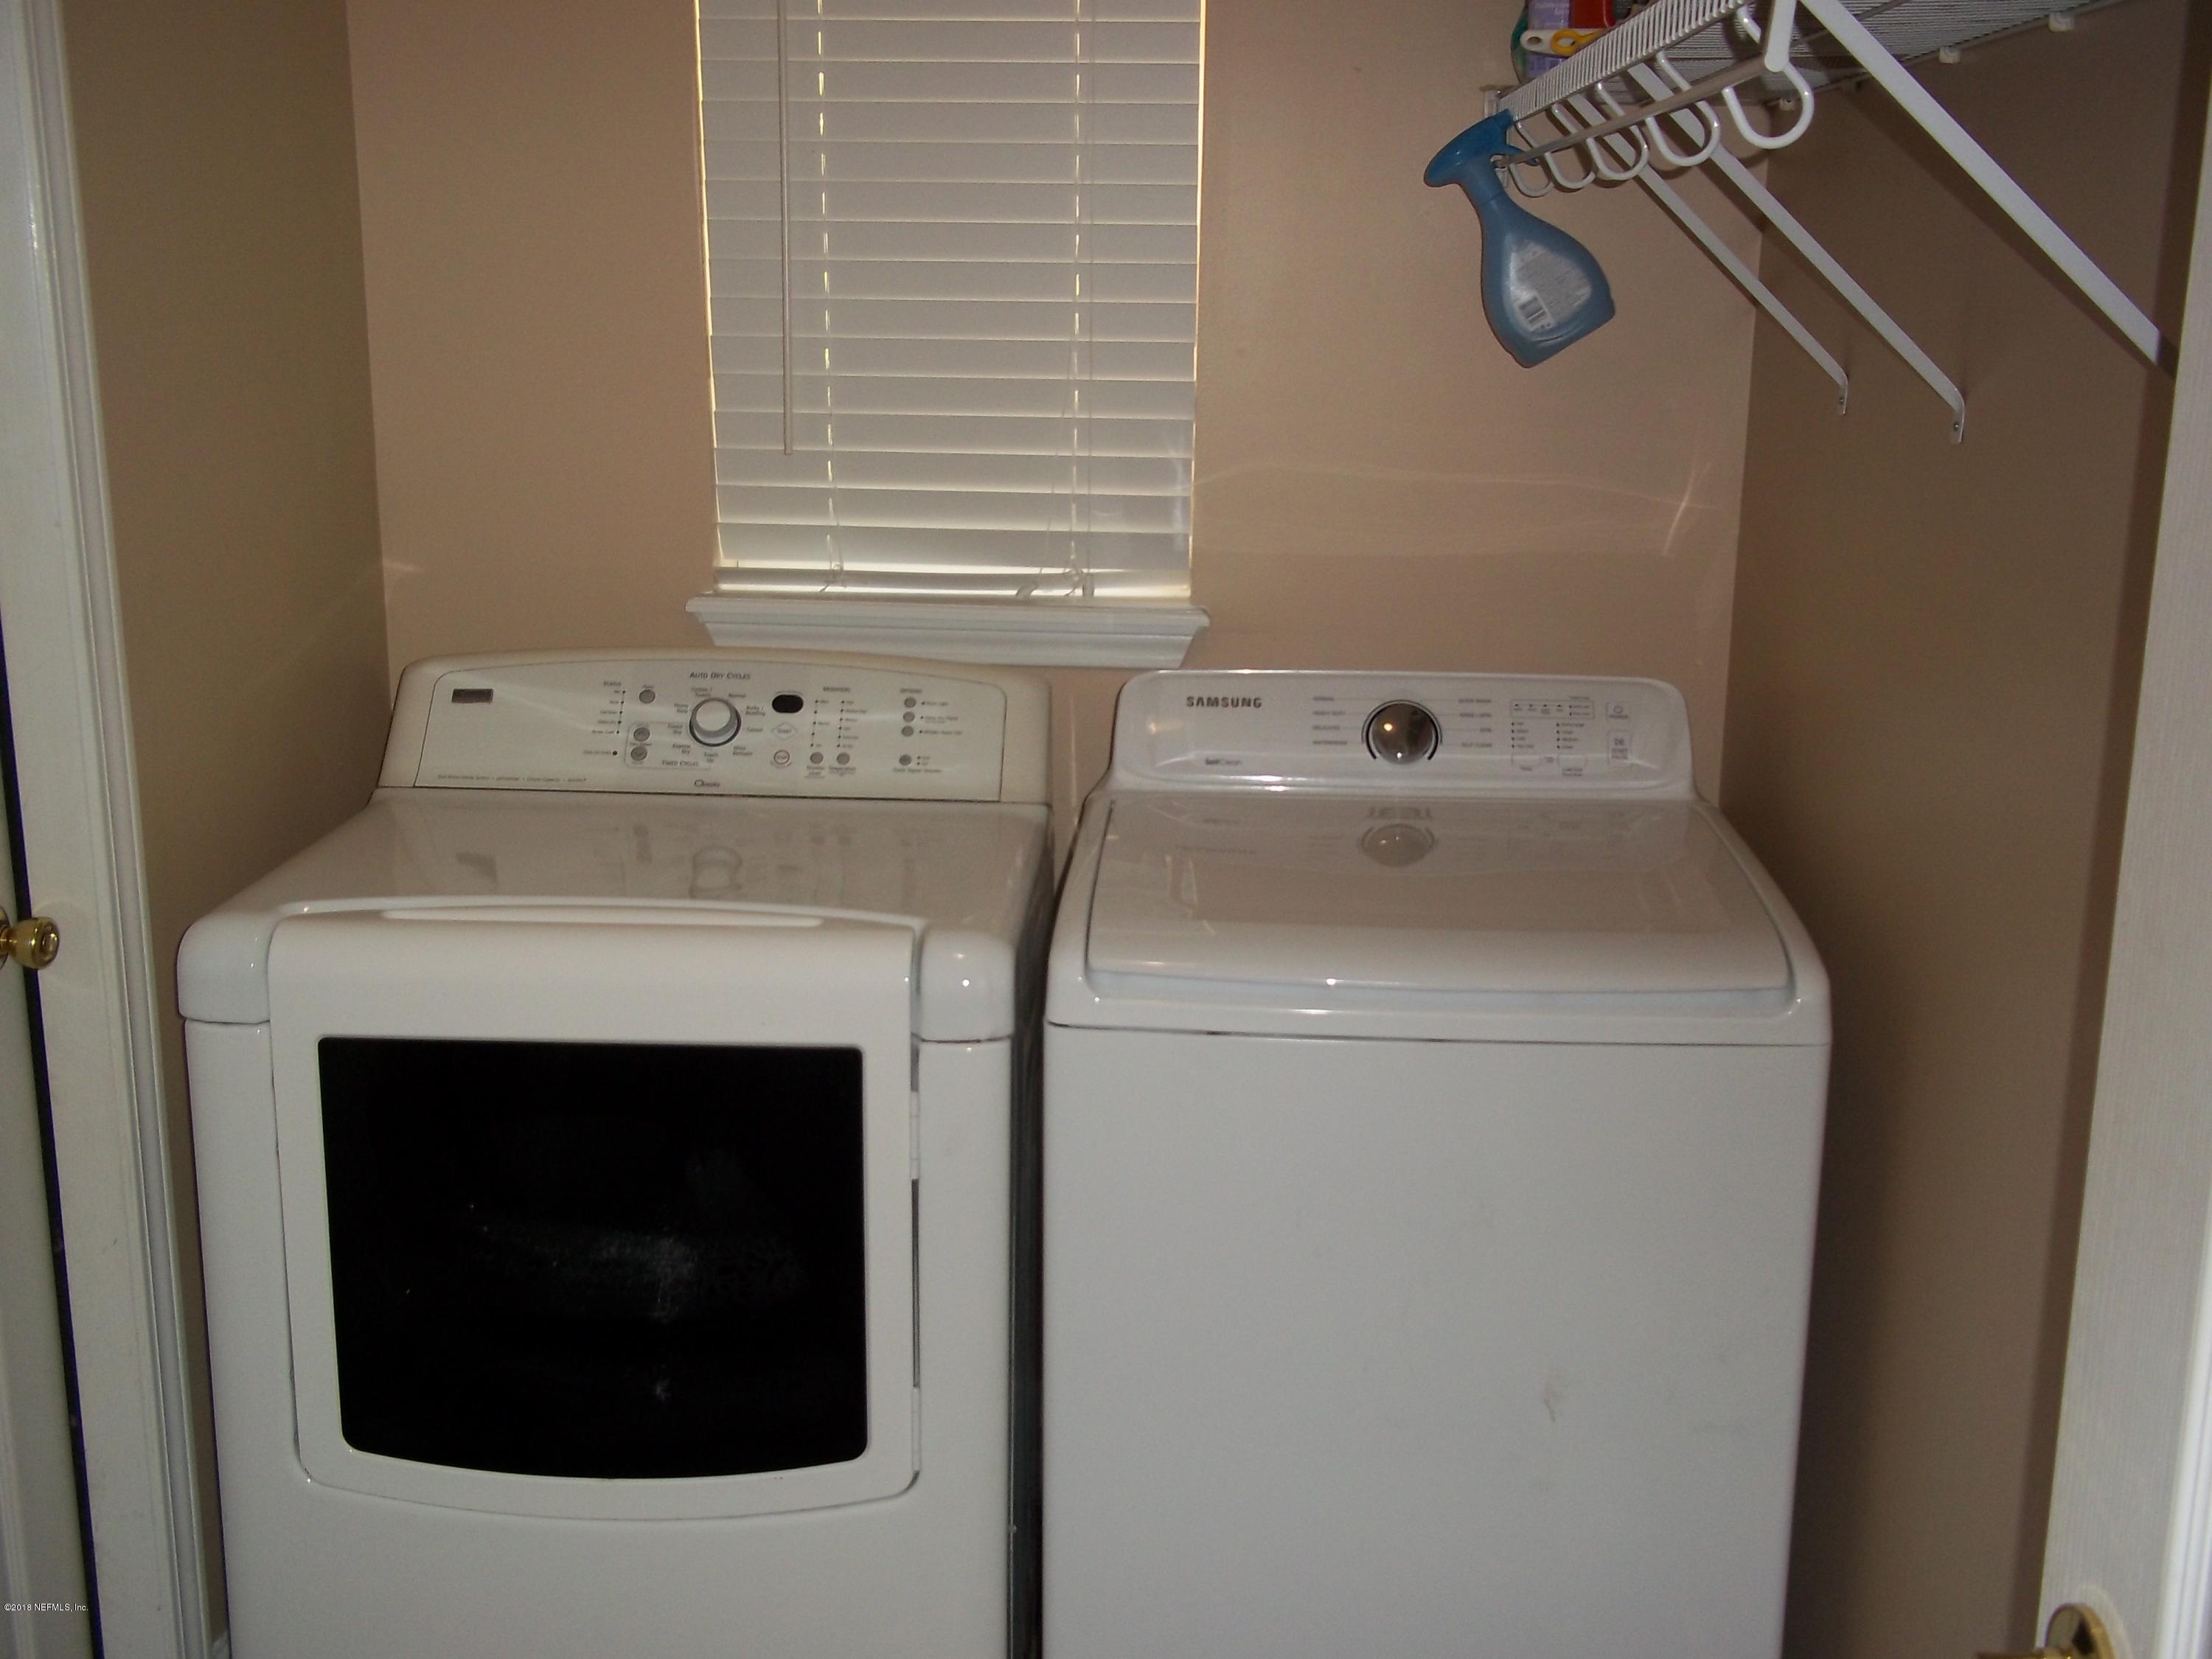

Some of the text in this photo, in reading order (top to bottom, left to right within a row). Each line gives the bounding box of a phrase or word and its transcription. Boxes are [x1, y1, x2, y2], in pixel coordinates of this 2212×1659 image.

[711, 672, 724, 680] DRY
[726, 672, 751, 680] CYCLES
[1186, 695, 1262, 709] SAMSUNG
